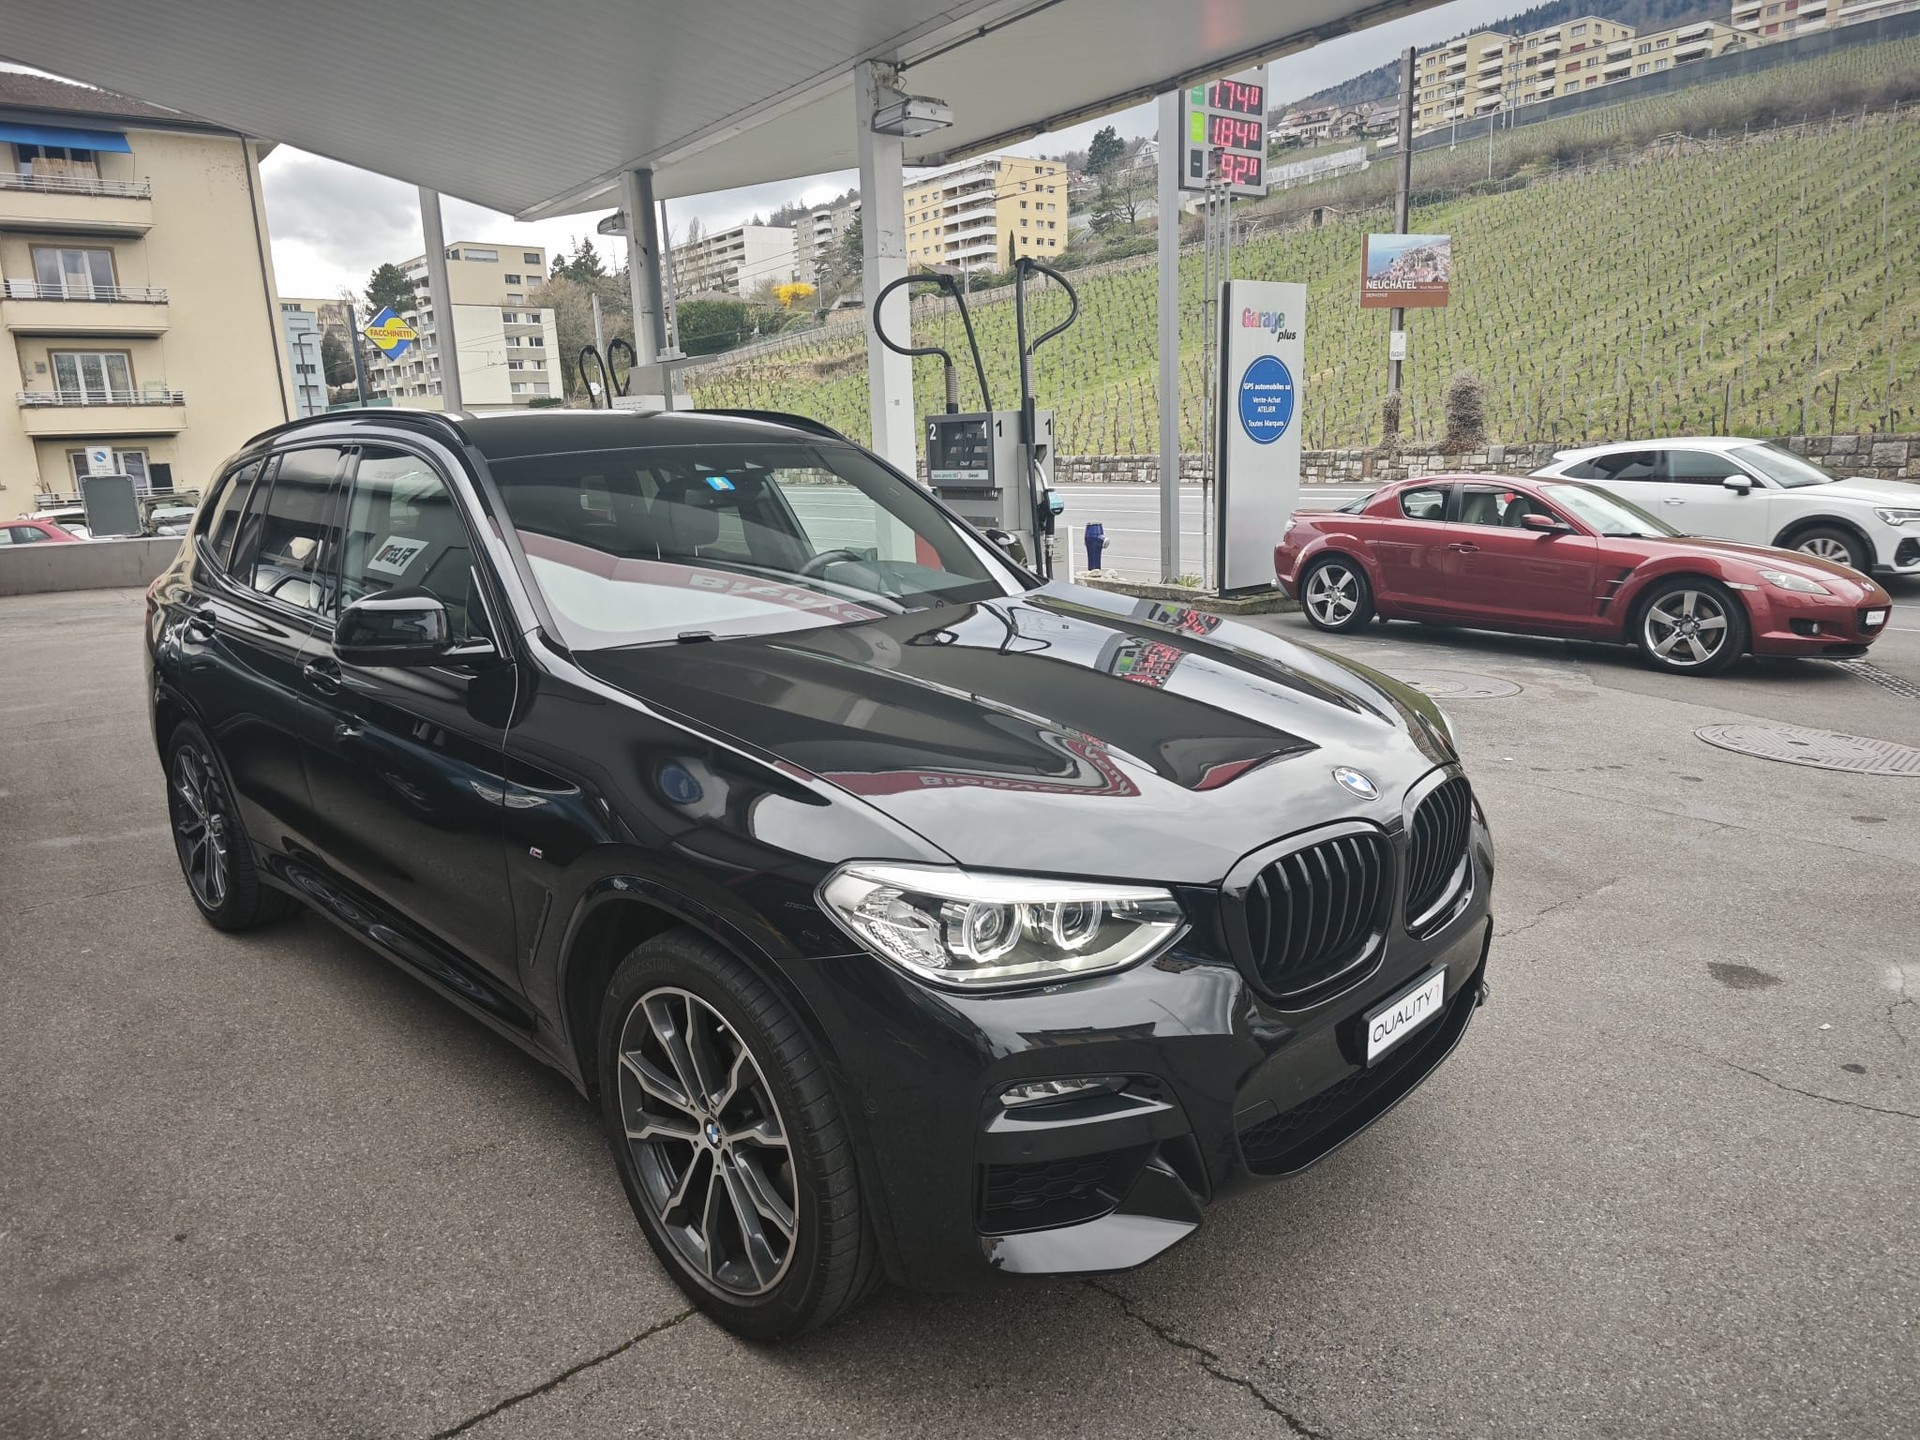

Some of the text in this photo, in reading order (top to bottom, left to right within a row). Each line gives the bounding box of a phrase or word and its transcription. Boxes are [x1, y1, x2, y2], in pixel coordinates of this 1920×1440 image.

[1242, 307, 1286, 334] Garage
[370, 329, 412, 338] FACCHINETTI
[1277, 329, 1297, 342] plus
[1243, 382, 1254, 390] GPS
[1255, 382, 1284, 390] automobiles
[1257, 405, 1276, 413] ATELIER
[929, 423, 937, 440] 2
[981, 421, 987, 439] 1
[995, 419, 1002, 438] 1
[1045, 418, 1052, 436] 1
[1248, 419, 1284, 428] Toutes Marques
[1373, 987, 1433, 1043] QUALITY
